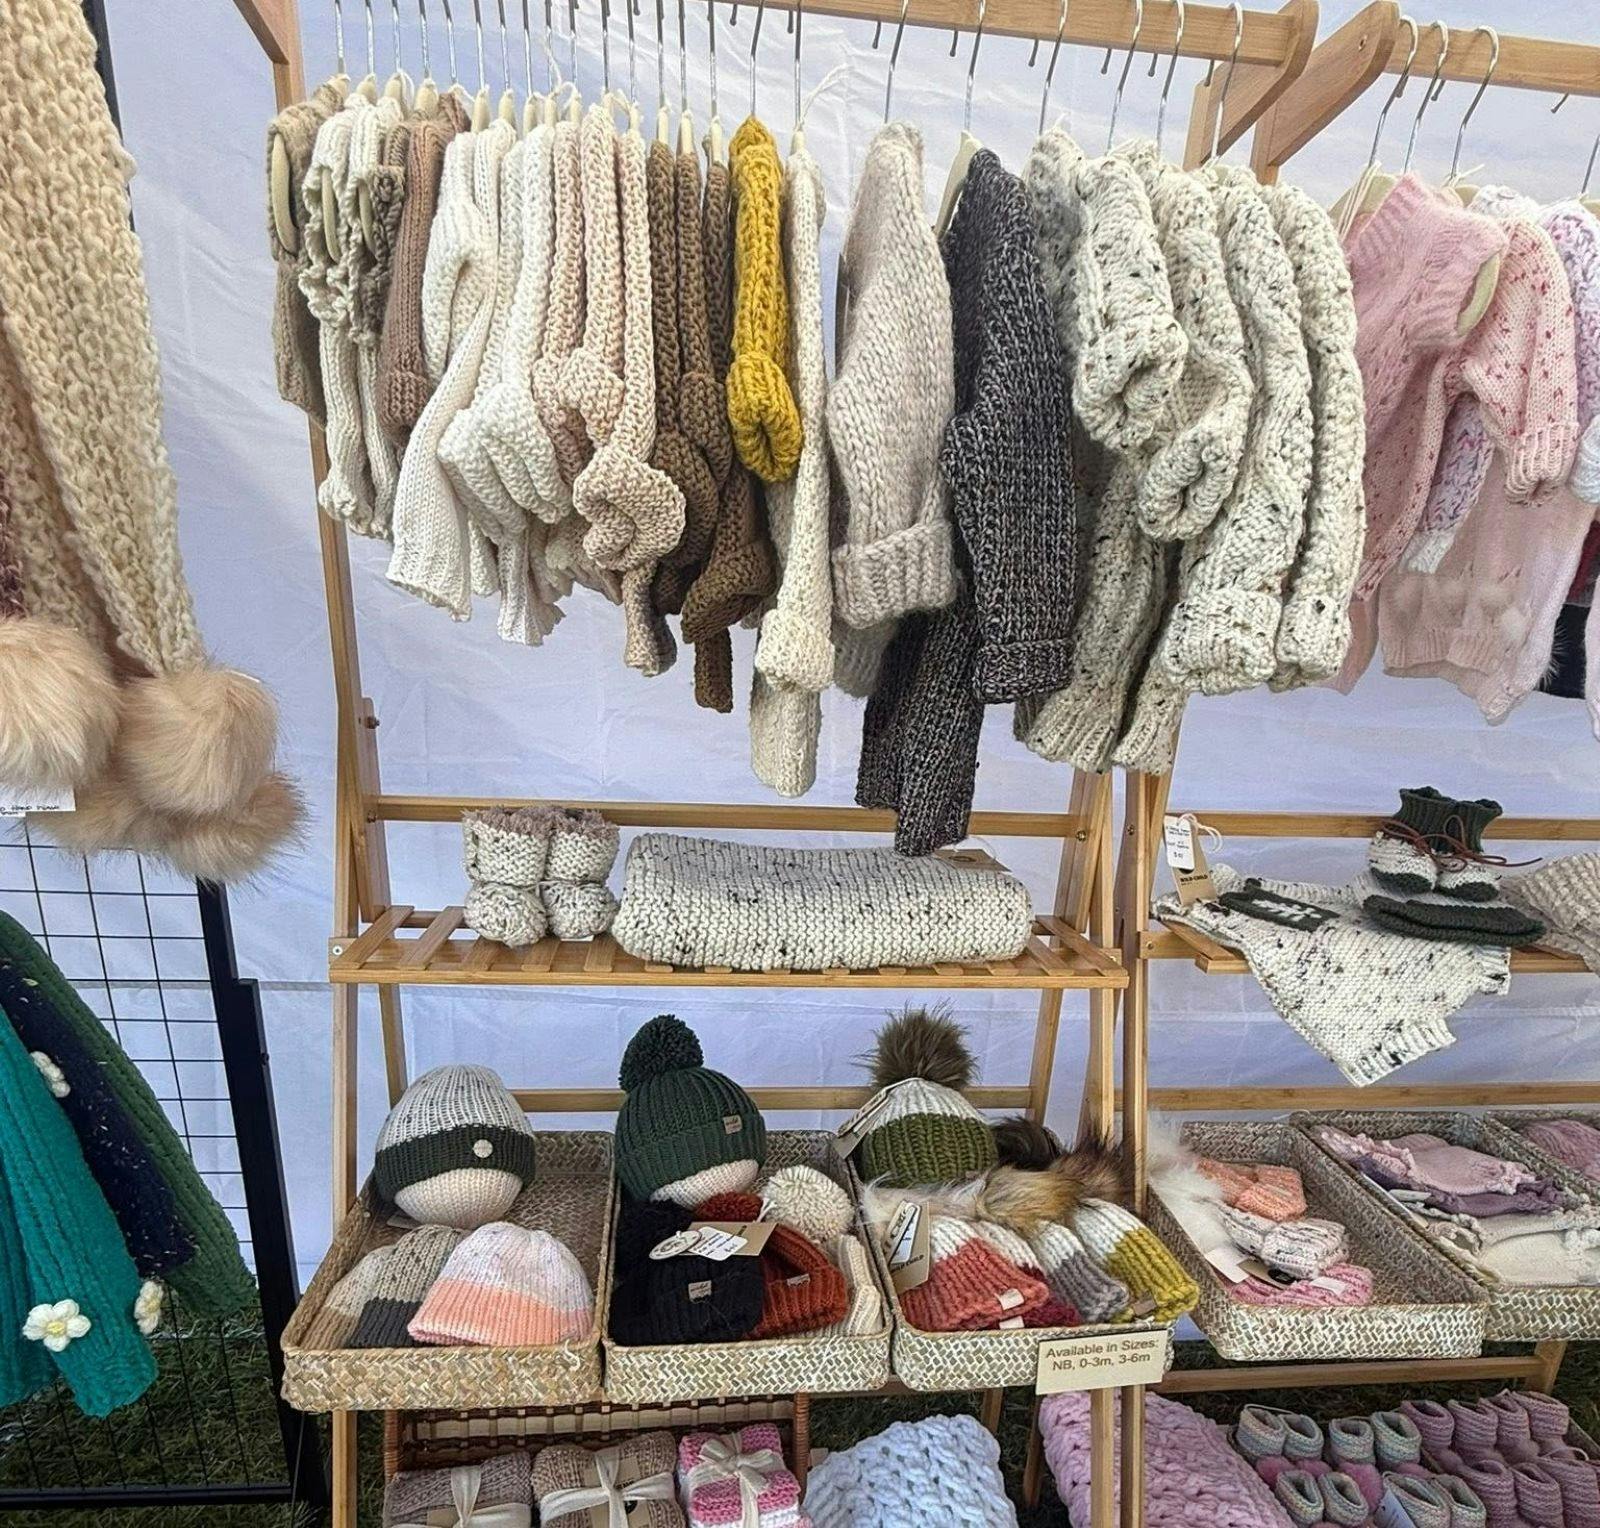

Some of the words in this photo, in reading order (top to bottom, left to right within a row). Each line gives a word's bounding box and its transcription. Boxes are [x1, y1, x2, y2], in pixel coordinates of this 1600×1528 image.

[1046, 1343, 1103, 1358] Available
[1106, 1342, 1118, 1353] in
[1121, 1339, 1159, 1351] Sizes:
[1052, 1359, 1076, 1371] NB,
[1079, 1356, 1115, 1368] 0-3m,
[1118, 1353, 1151, 1364] 3-6m
